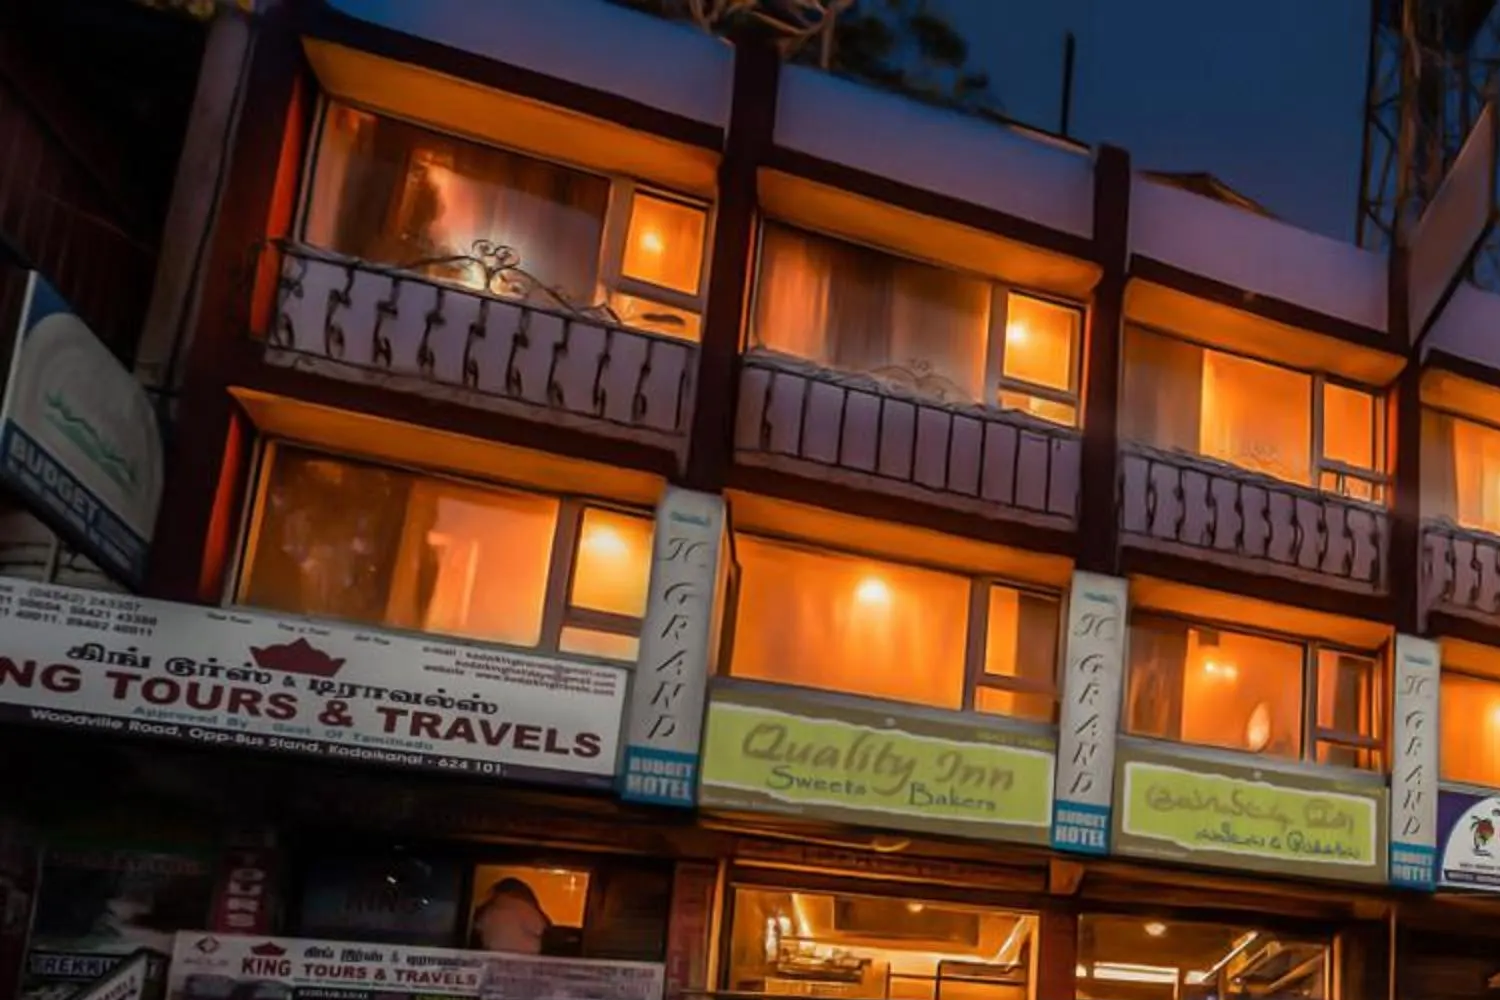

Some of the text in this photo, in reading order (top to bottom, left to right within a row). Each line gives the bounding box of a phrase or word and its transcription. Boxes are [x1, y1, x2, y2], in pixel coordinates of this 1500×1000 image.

[29, 707, 125, 732] Woodville
[127, 719, 183, 738] Road,
[268, 736, 324, 754] Stand,
[327, 742, 425, 766] Kodaikanal
[105, 671, 299, 720] TOURS
[317, 699, 355, 728] &
[375, 705, 603, 760] TRAVELS
[742, 722, 1015, 797] Quality Inn
[626, 773, 692, 799] HOTEL
[765, 764, 997, 812] Sweets Bakers
[240, 957, 292, 978] KING
[303, 962, 367, 979] TOURS
[373, 967, 387, 980] &
[396, 968, 478, 986] TRAVELS
